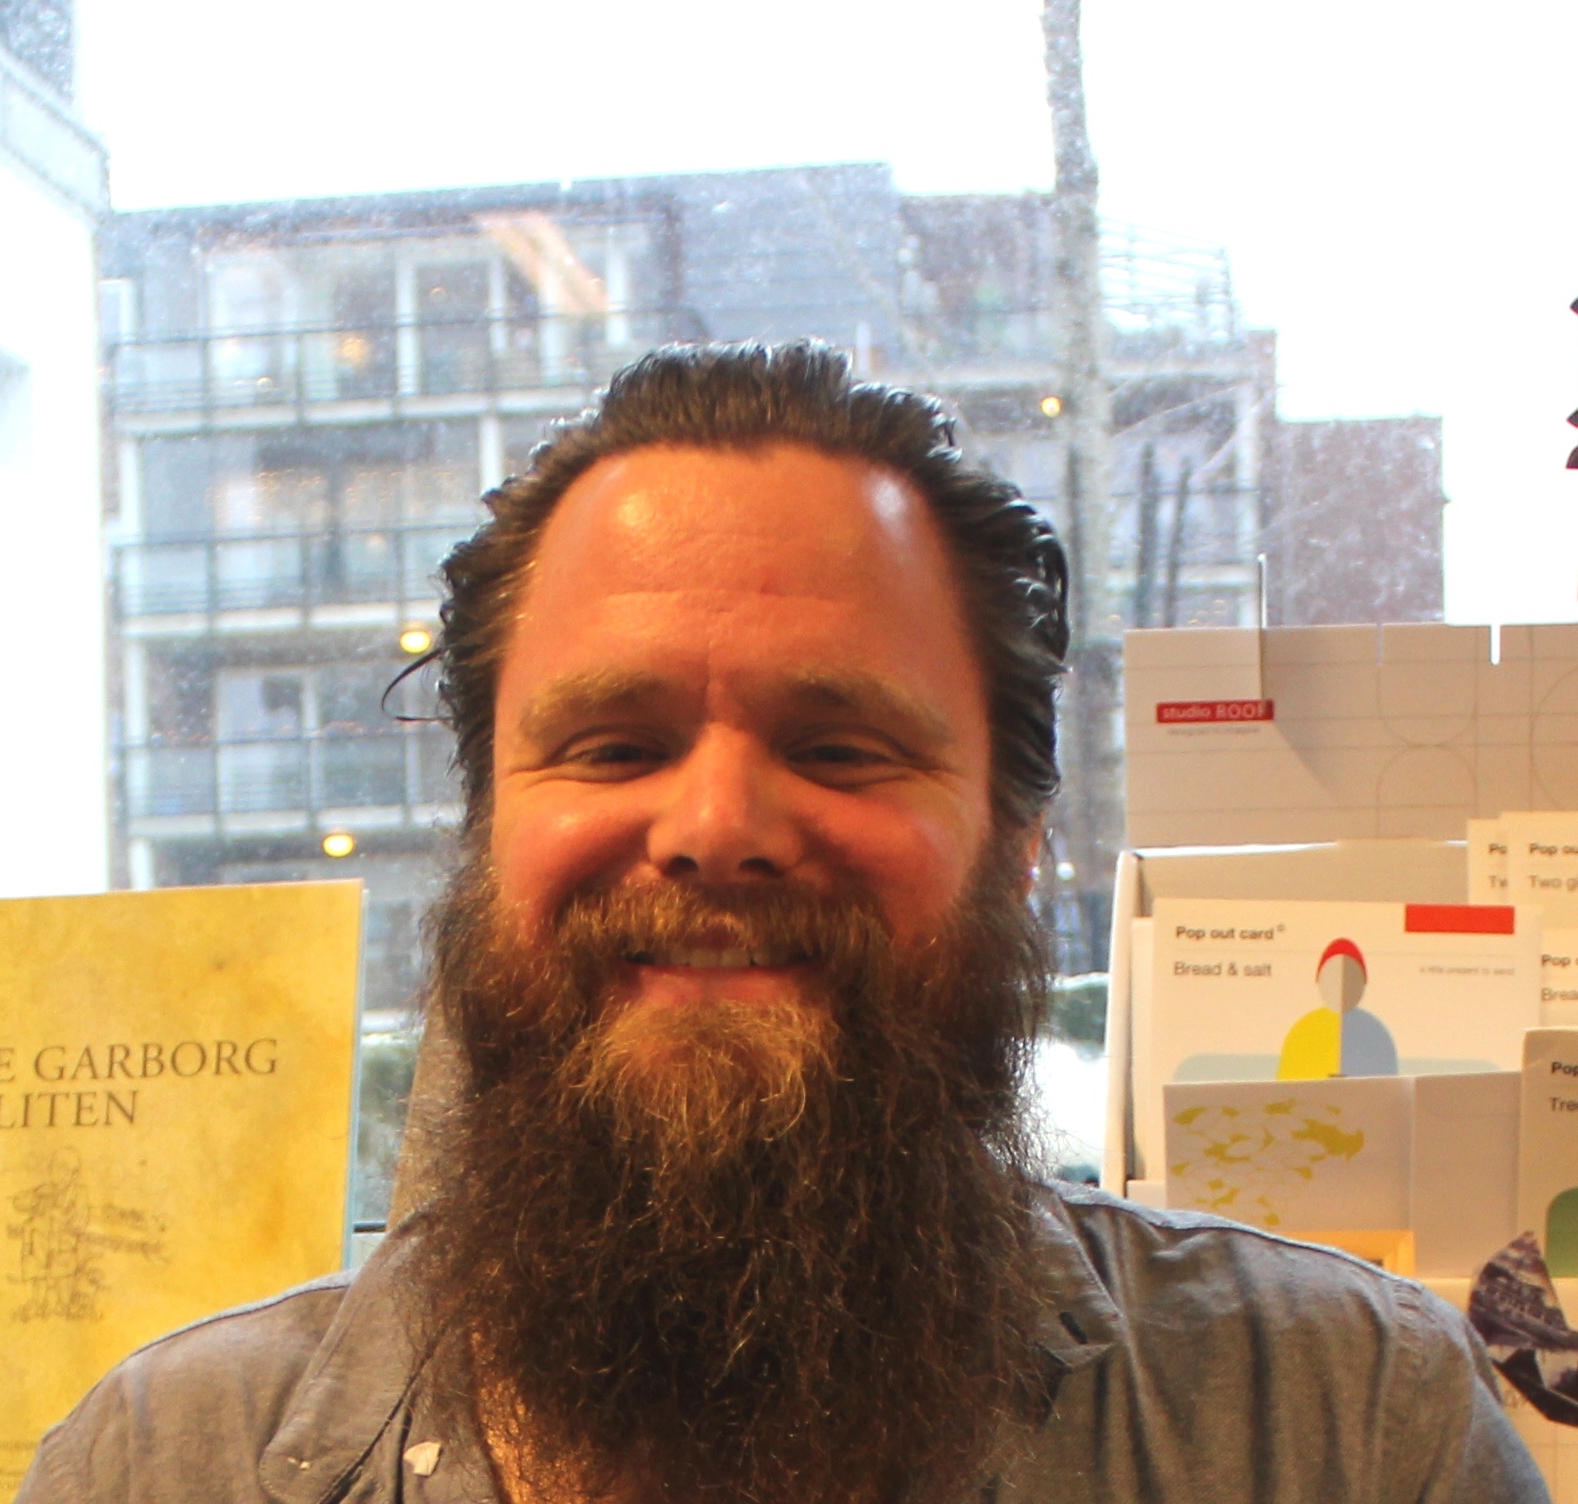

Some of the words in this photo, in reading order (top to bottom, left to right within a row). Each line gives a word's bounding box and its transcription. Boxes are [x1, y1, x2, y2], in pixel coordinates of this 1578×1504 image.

[1529, 843, 1558, 858] Pop
[1528, 875, 1562, 889] Two
[1176, 926, 1206, 941] Pop
[1211, 927, 1235, 939] out
[1241, 926, 1274, 940] card
[1541, 953, 1570, 968] Pop
[1174, 961, 1221, 976] Bread
[1227, 961, 1238, 975] &
[1243, 961, 1272, 976] salt
[33, 1037, 279, 1082] GARBORG
